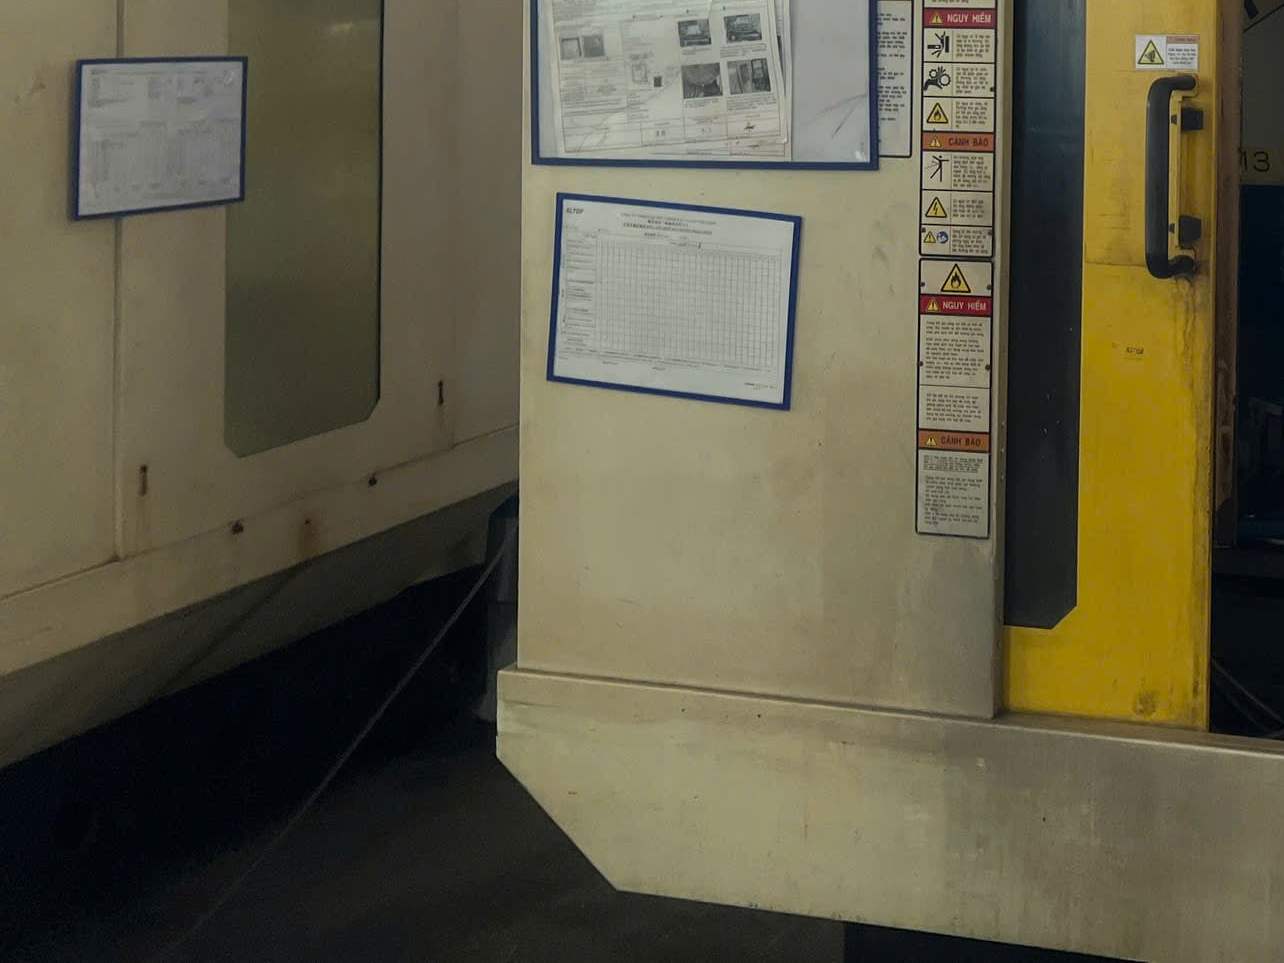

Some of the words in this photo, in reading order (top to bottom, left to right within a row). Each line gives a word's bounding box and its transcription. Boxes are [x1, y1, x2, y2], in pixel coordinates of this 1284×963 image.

[947, 13, 969, 23] NGUY
[1239, 149, 1271, 173] 13
[942, 300, 964, 310] NGUY
